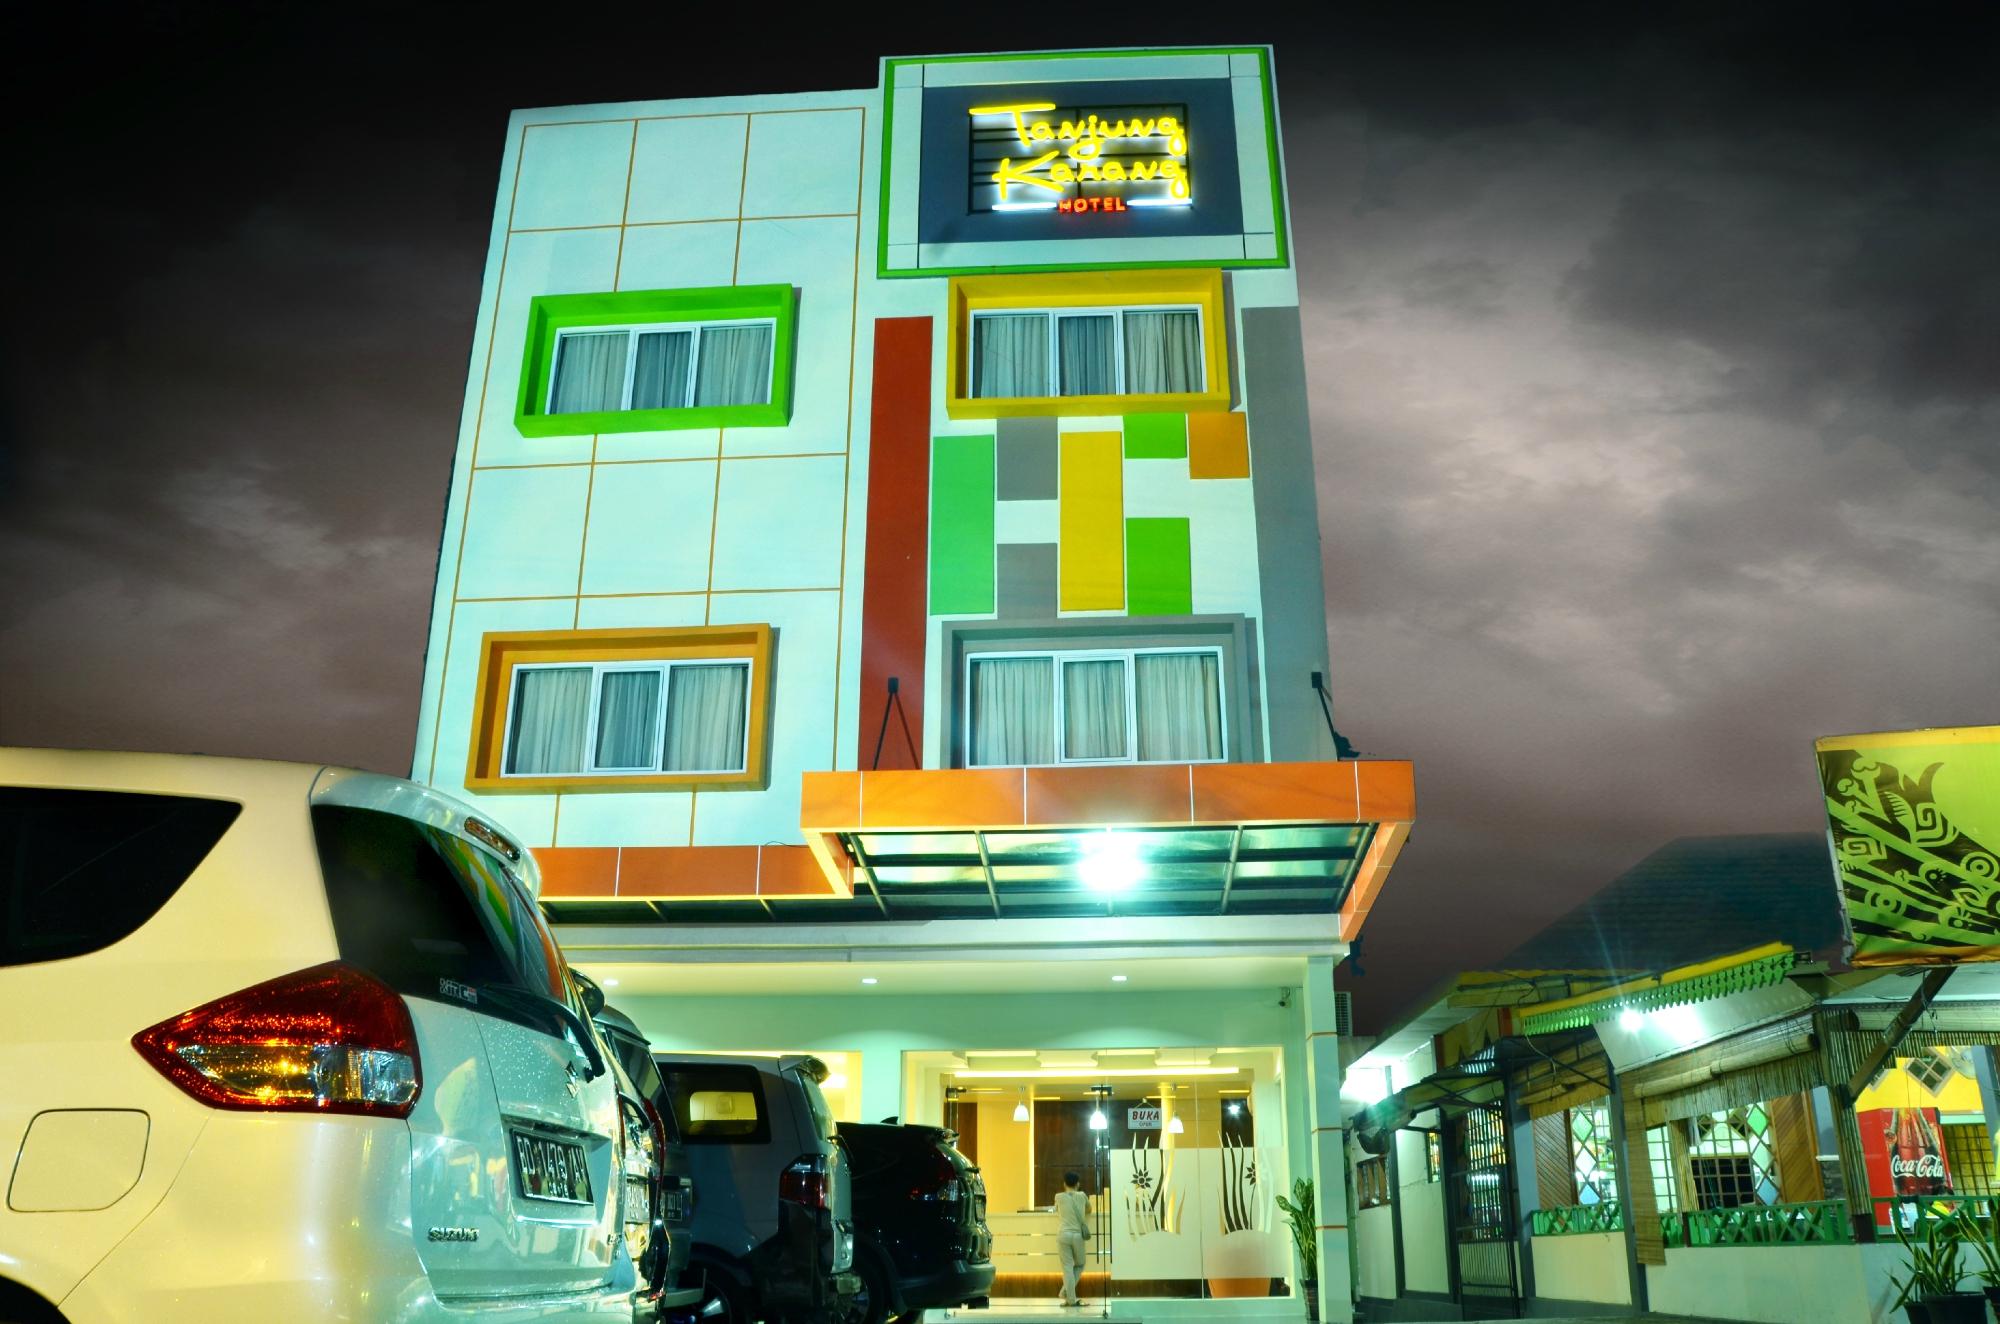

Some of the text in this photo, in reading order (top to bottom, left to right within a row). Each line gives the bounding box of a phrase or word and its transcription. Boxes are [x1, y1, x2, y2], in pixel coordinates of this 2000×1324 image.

[969, 103, 1187, 160] Tanjung
[992, 150, 1190, 200] Karang
[1058, 197, 1127, 213] HOTEL
[1132, 1111, 1160, 1120] BUKA
[1890, 1154, 1943, 1178] Coca-Cola
